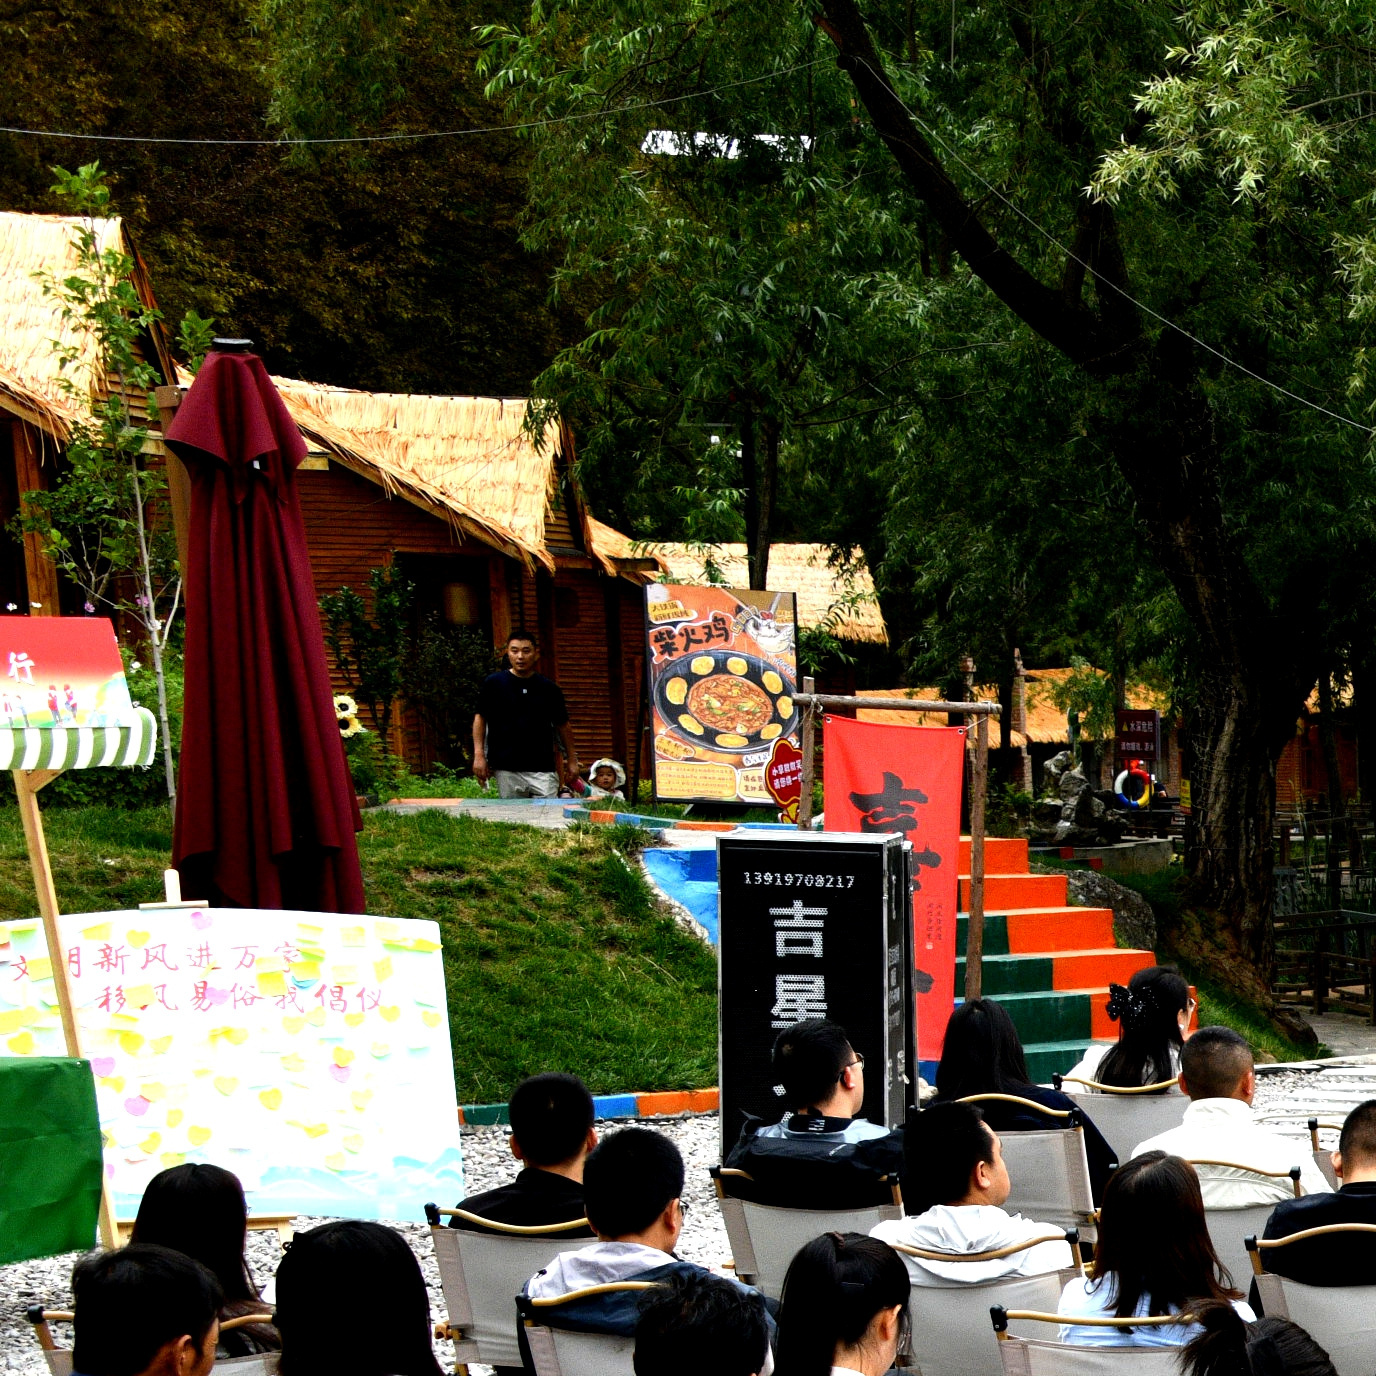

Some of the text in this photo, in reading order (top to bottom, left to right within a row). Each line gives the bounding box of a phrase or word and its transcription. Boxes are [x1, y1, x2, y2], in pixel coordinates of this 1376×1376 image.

[653, 615, 730, 656] 柴火鸡
[8, 651, 35, 686] 行
[743, 871, 855, 888] 13919708217
[769, 899, 829, 1123] 吉星
